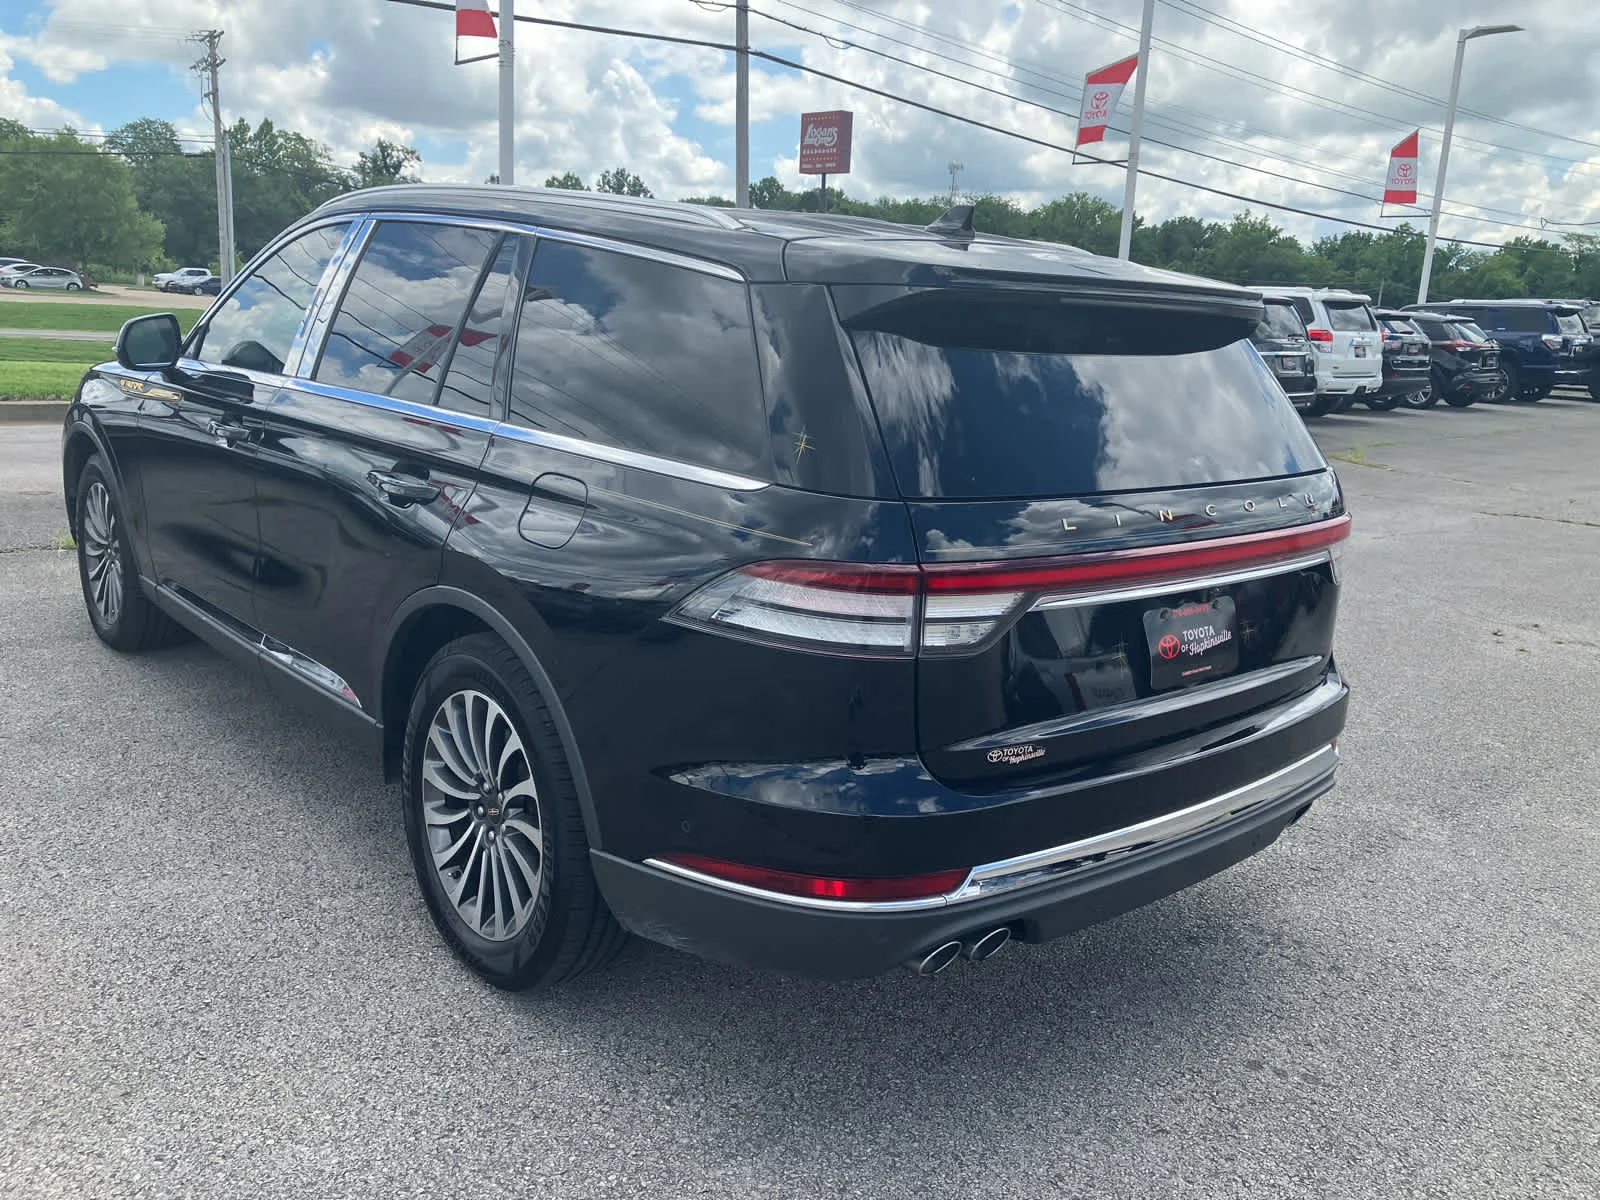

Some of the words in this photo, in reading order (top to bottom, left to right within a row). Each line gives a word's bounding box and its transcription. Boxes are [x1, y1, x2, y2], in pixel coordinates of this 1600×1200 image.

[1391, 177, 1416, 185] TOYOTA
[1062, 493, 1314, 531] LINCOLN
[1182, 625, 1216, 642] TOYOTA
[1189, 629, 1232, 656] Hopkinsville
[1004, 745, 1033, 756] TOYOTA
